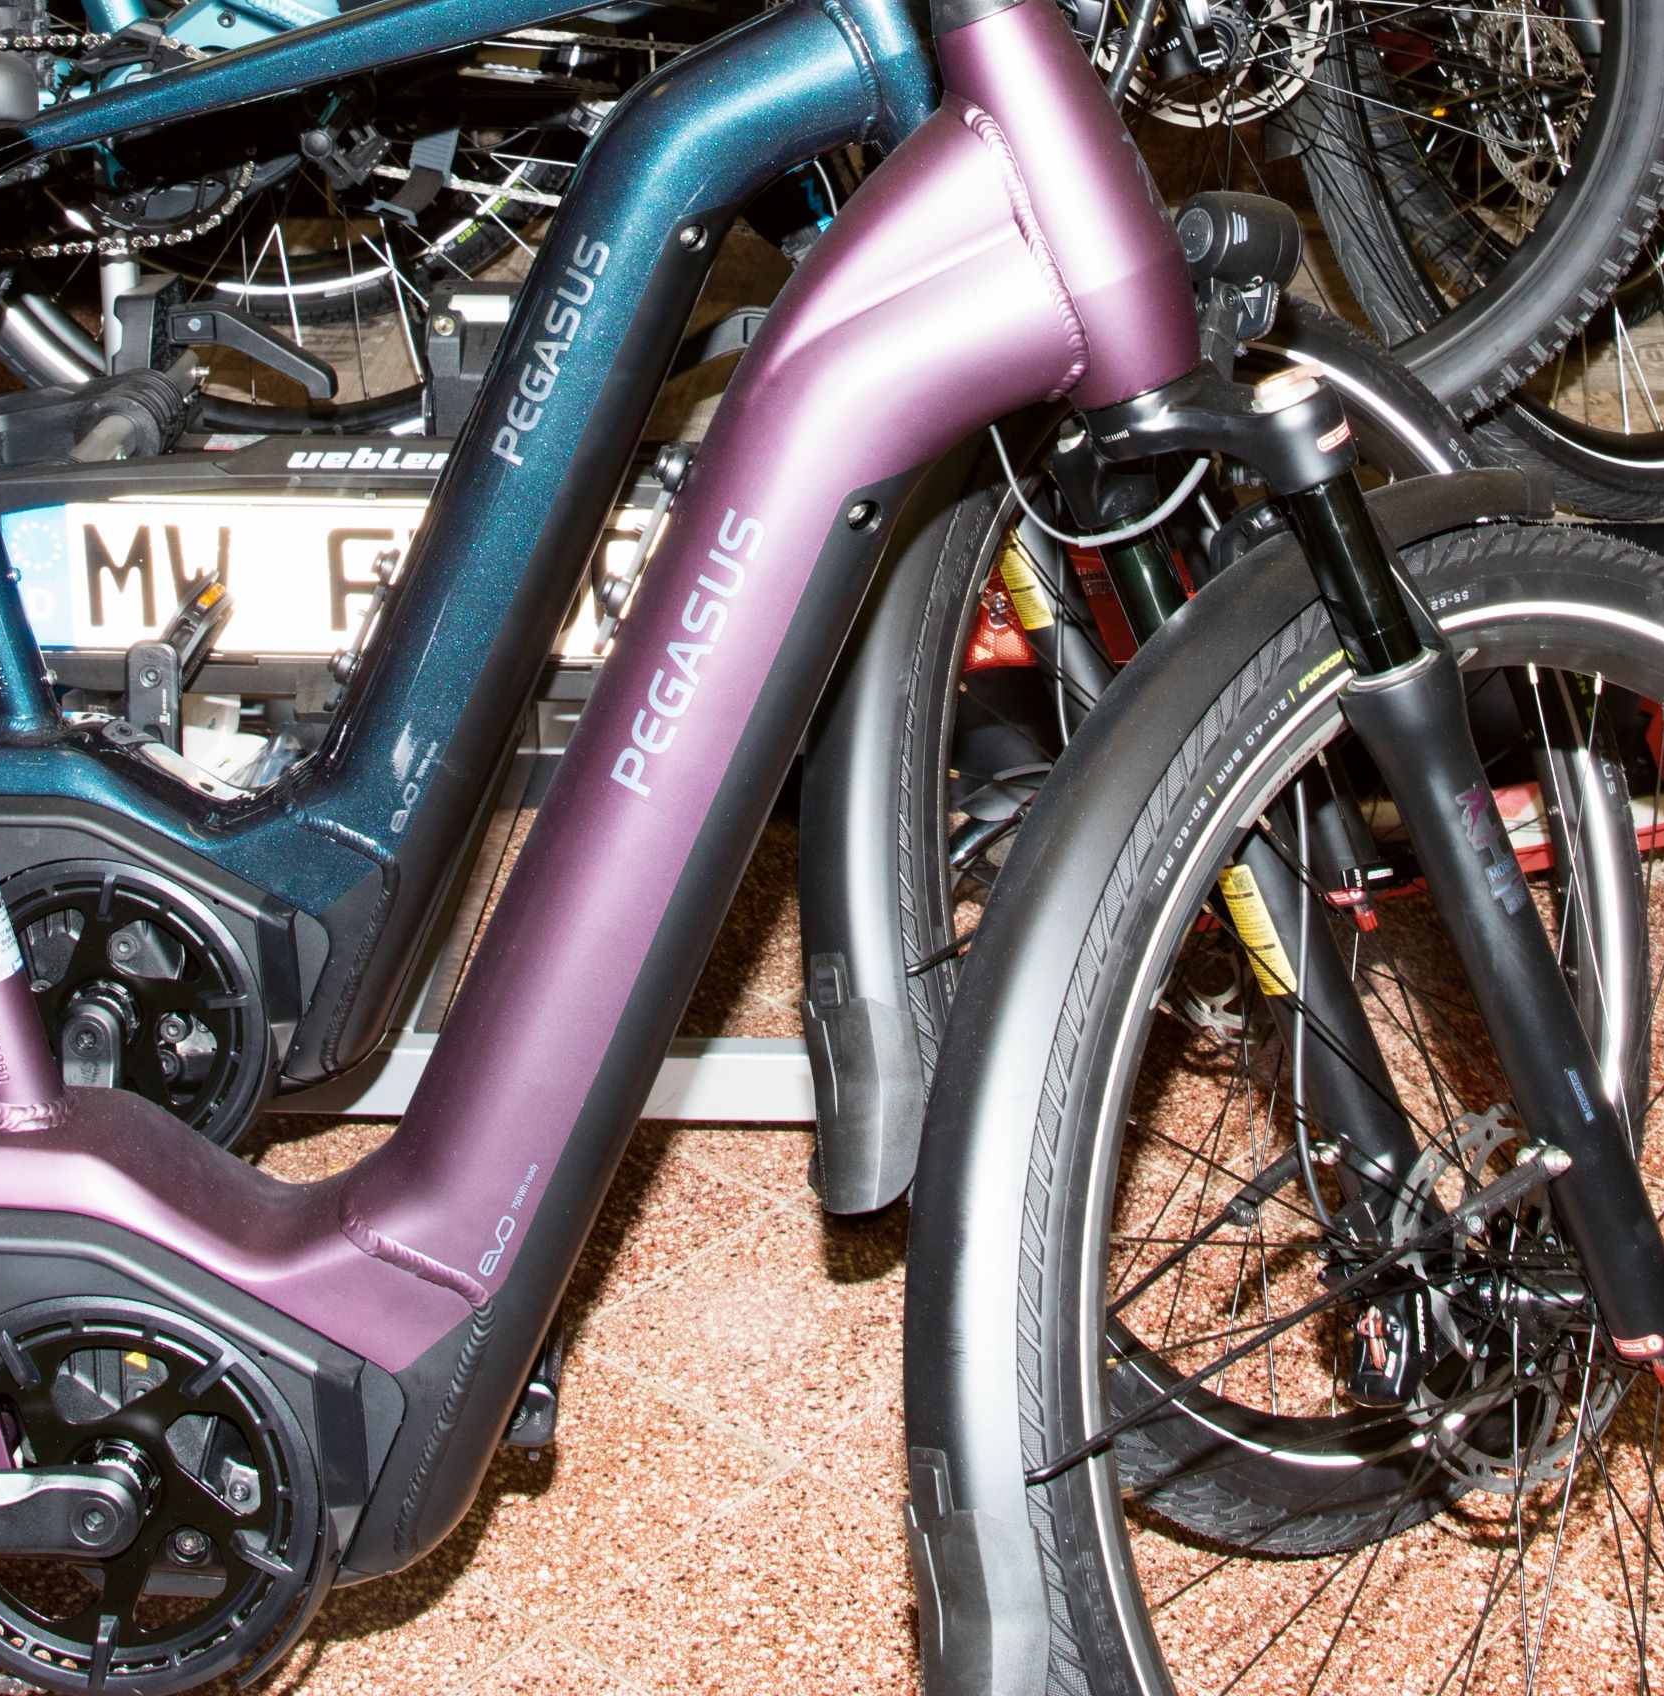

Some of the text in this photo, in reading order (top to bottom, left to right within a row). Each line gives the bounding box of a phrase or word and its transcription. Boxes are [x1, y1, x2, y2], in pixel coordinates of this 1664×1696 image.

[491, 233, 611, 467] PEGASUS
[286, 447, 451, 470] uebler
[1429, 590, 1470, 611] 55-62
[609, 507, 767, 799] PEGASUS
[1245, 698, 1289, 746] 2.0-4.0
[1216, 751, 1245, 786] BAR
[390, 781, 419, 834] EVO
[1174, 794, 1211, 847] 30-60
[1152, 847, 1176, 887] PSI
[509, 1161, 540, 1212] 750Wh ready
[477, 1214, 517, 1278] EVO
[1414, 1292, 1428, 1354] TEKTRO
